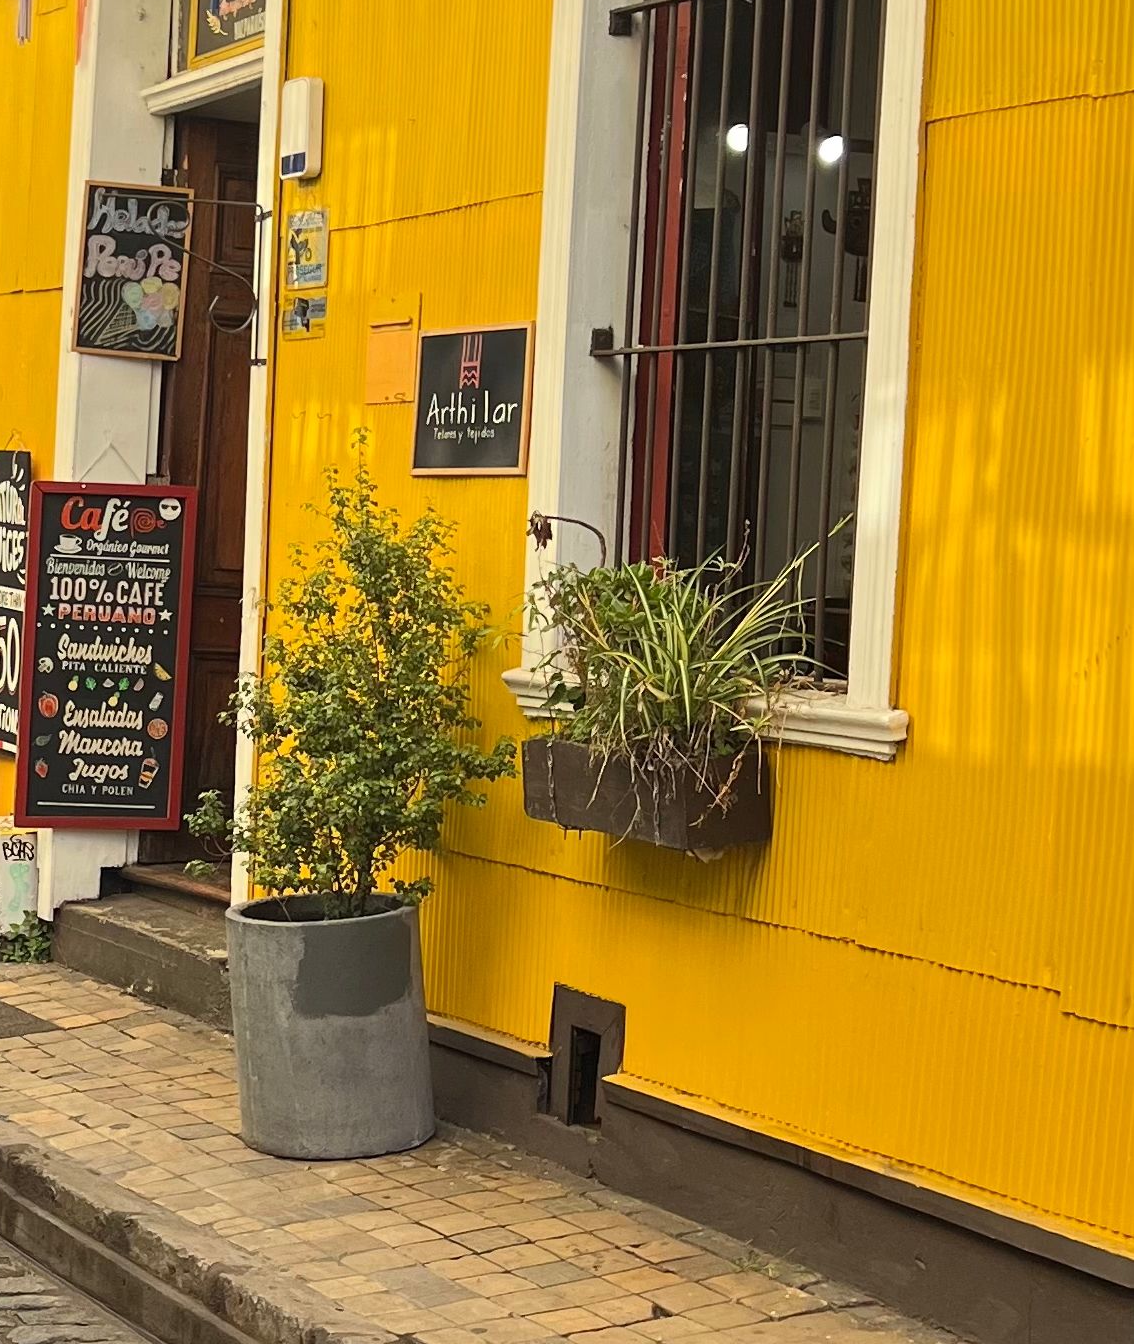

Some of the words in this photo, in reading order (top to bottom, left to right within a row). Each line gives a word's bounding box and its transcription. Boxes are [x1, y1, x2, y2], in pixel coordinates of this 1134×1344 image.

[467, 426, 495, 445] tejidos
[60, 496, 131, 541] Café
[129, 541, 169, 557] Gourmet
[46, 557, 106, 577] Bienvenidos
[126, 561, 171, 581] Welcome
[57, 602, 157, 626] PERUANO
[57, 633, 153, 665] Sandwiches
[61, 660, 86, 672] PITA
[94, 662, 148, 675] CALIENTE
[63, 699, 144, 731] Ensaladas
[68, 757, 130, 784] Jugos
[61, 783, 86, 795] CHIA
[91, 785, 97, 796] Y
[101, 785, 134, 796] POLEN
